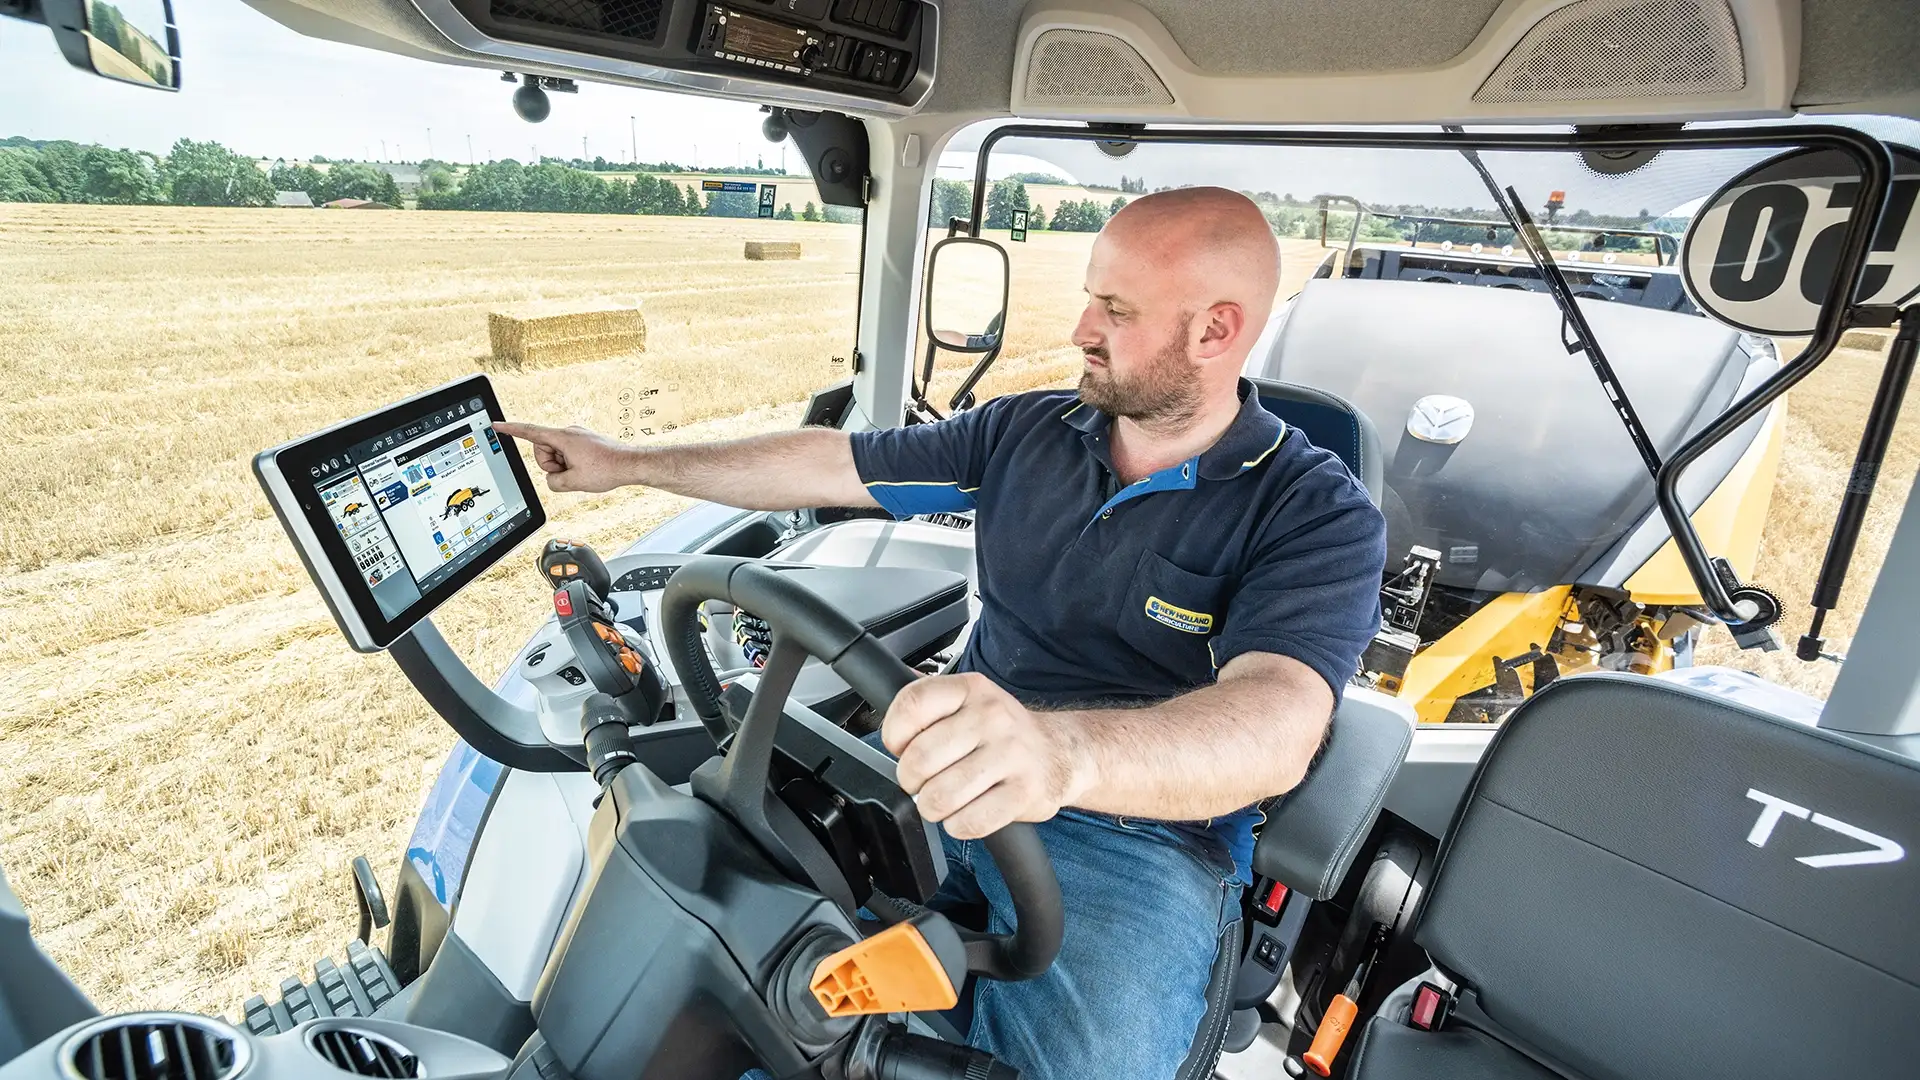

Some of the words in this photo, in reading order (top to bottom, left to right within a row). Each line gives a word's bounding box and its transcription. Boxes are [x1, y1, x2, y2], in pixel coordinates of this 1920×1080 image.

[1155, 614, 1200, 632] AGRICULTURE
[1159, 605, 1176, 618] NEW
[1176, 612, 1209, 625] HOLLAND
[1745, 787, 1905, 869] T7
